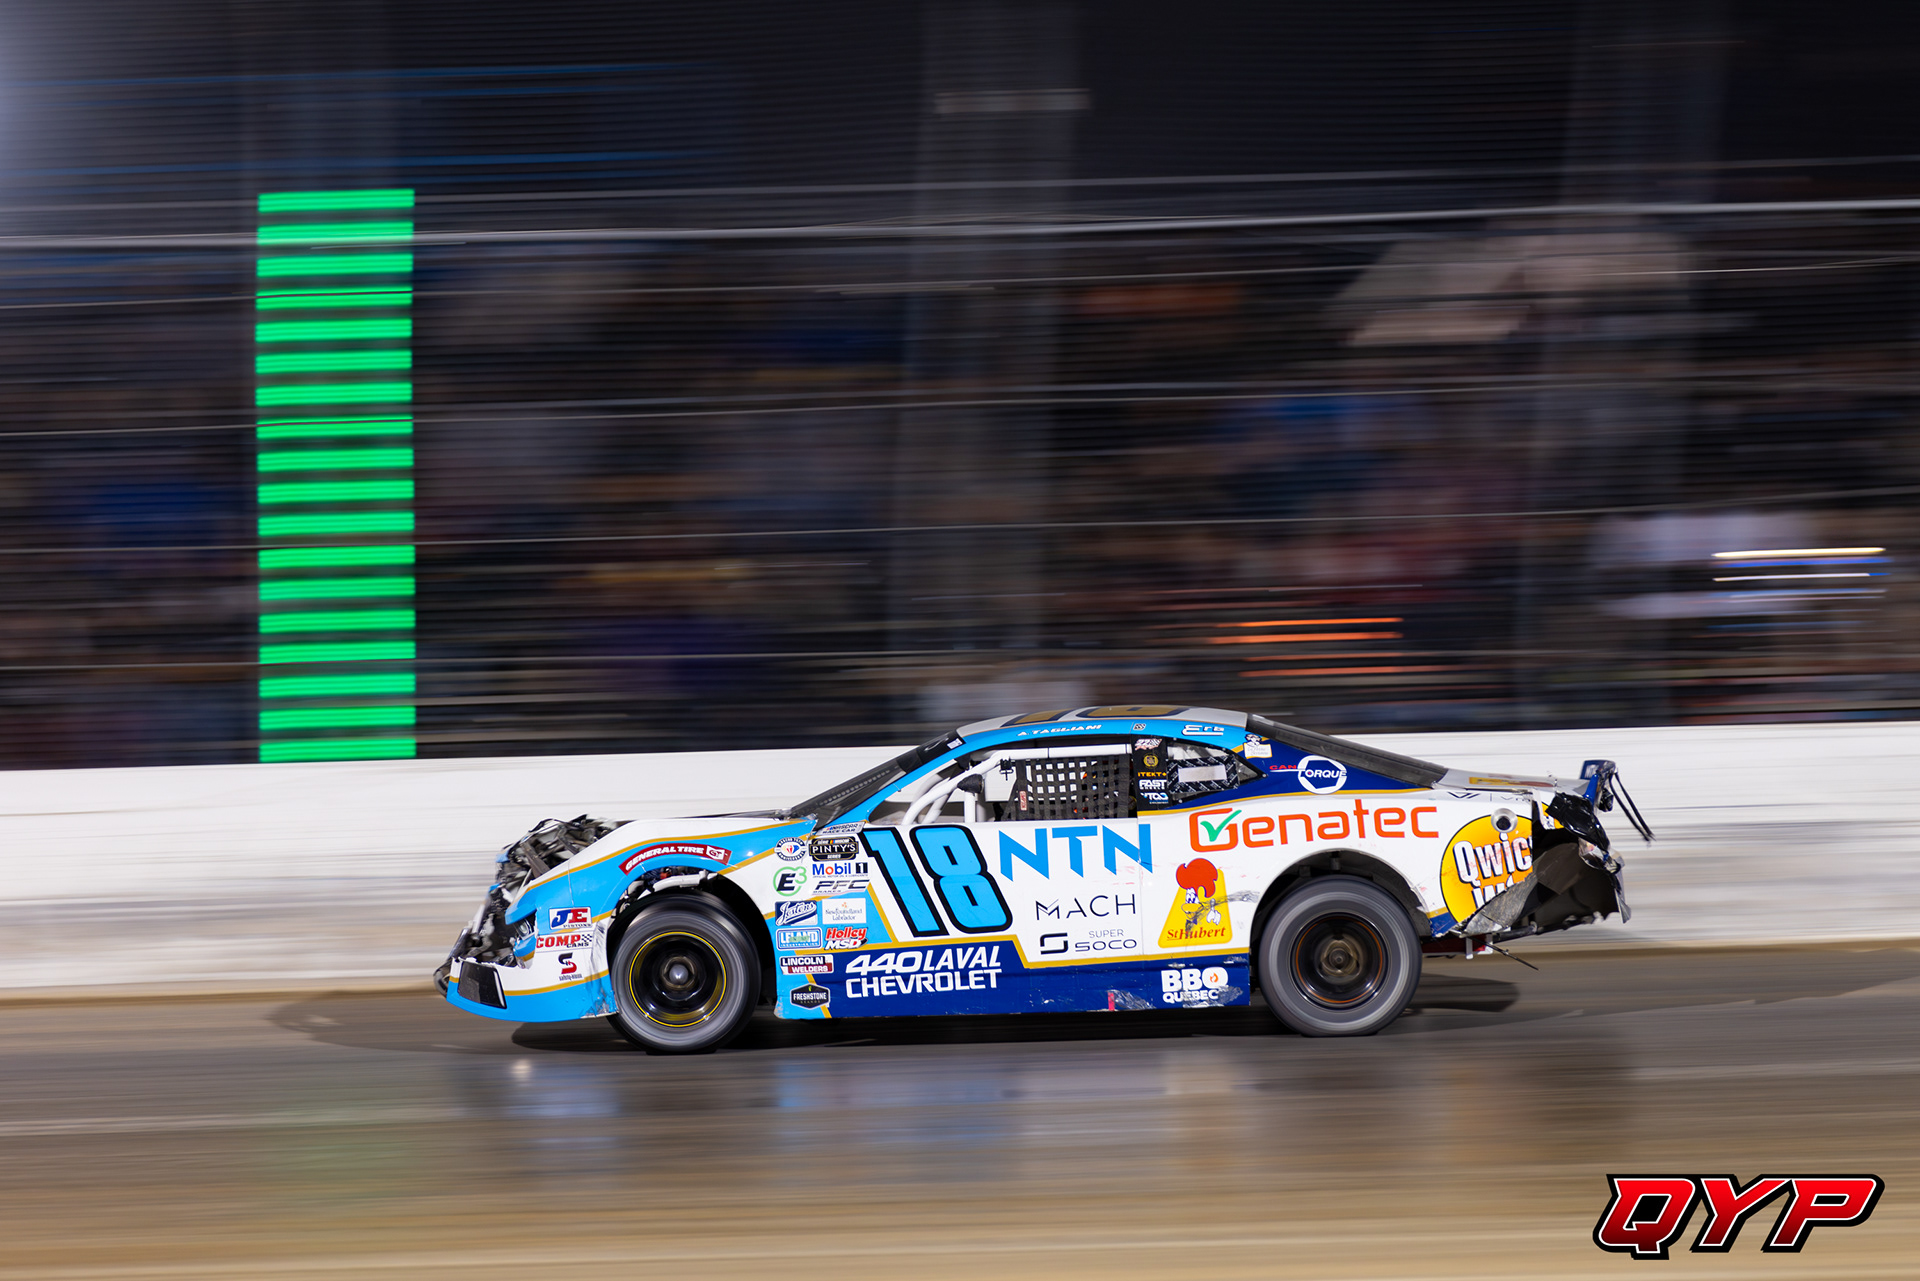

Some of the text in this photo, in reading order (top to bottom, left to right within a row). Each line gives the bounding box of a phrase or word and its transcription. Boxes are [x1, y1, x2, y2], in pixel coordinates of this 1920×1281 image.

[1298, 769, 1347, 778] TORQUE
[1139, 779, 1167, 787] FAST
[1189, 799, 1438, 852] Genatec
[812, 843, 856, 853] PINTY'S
[998, 824, 1153, 882] NTN
[625, 846, 676, 871] GENERAL
[677, 846, 705, 854] TIRE
[1453, 832, 1532, 887] Qwic
[812, 862, 851, 875] Mobil
[815, 879, 870, 890] PFC
[860, 824, 1013, 938] 18
[1035, 893, 1136, 921] MACH
[552, 908, 588, 928] JE
[825, 926, 868, 940] Holley
[1089, 928, 1124, 938] SUPER
[536, 934, 581, 948] COMP
[824, 939, 862, 950] MSD
[1075, 939, 1137, 952] SOCO
[782, 957, 824, 966] LINCOLN
[923, 945, 1001, 971] LAVAL
[791, 965, 828, 973] WELDERS
[846, 968, 1002, 998] CHEVROLET
[1161, 967, 1229, 992] BBQ
[793, 992, 827, 1000] FRESHSTONE
